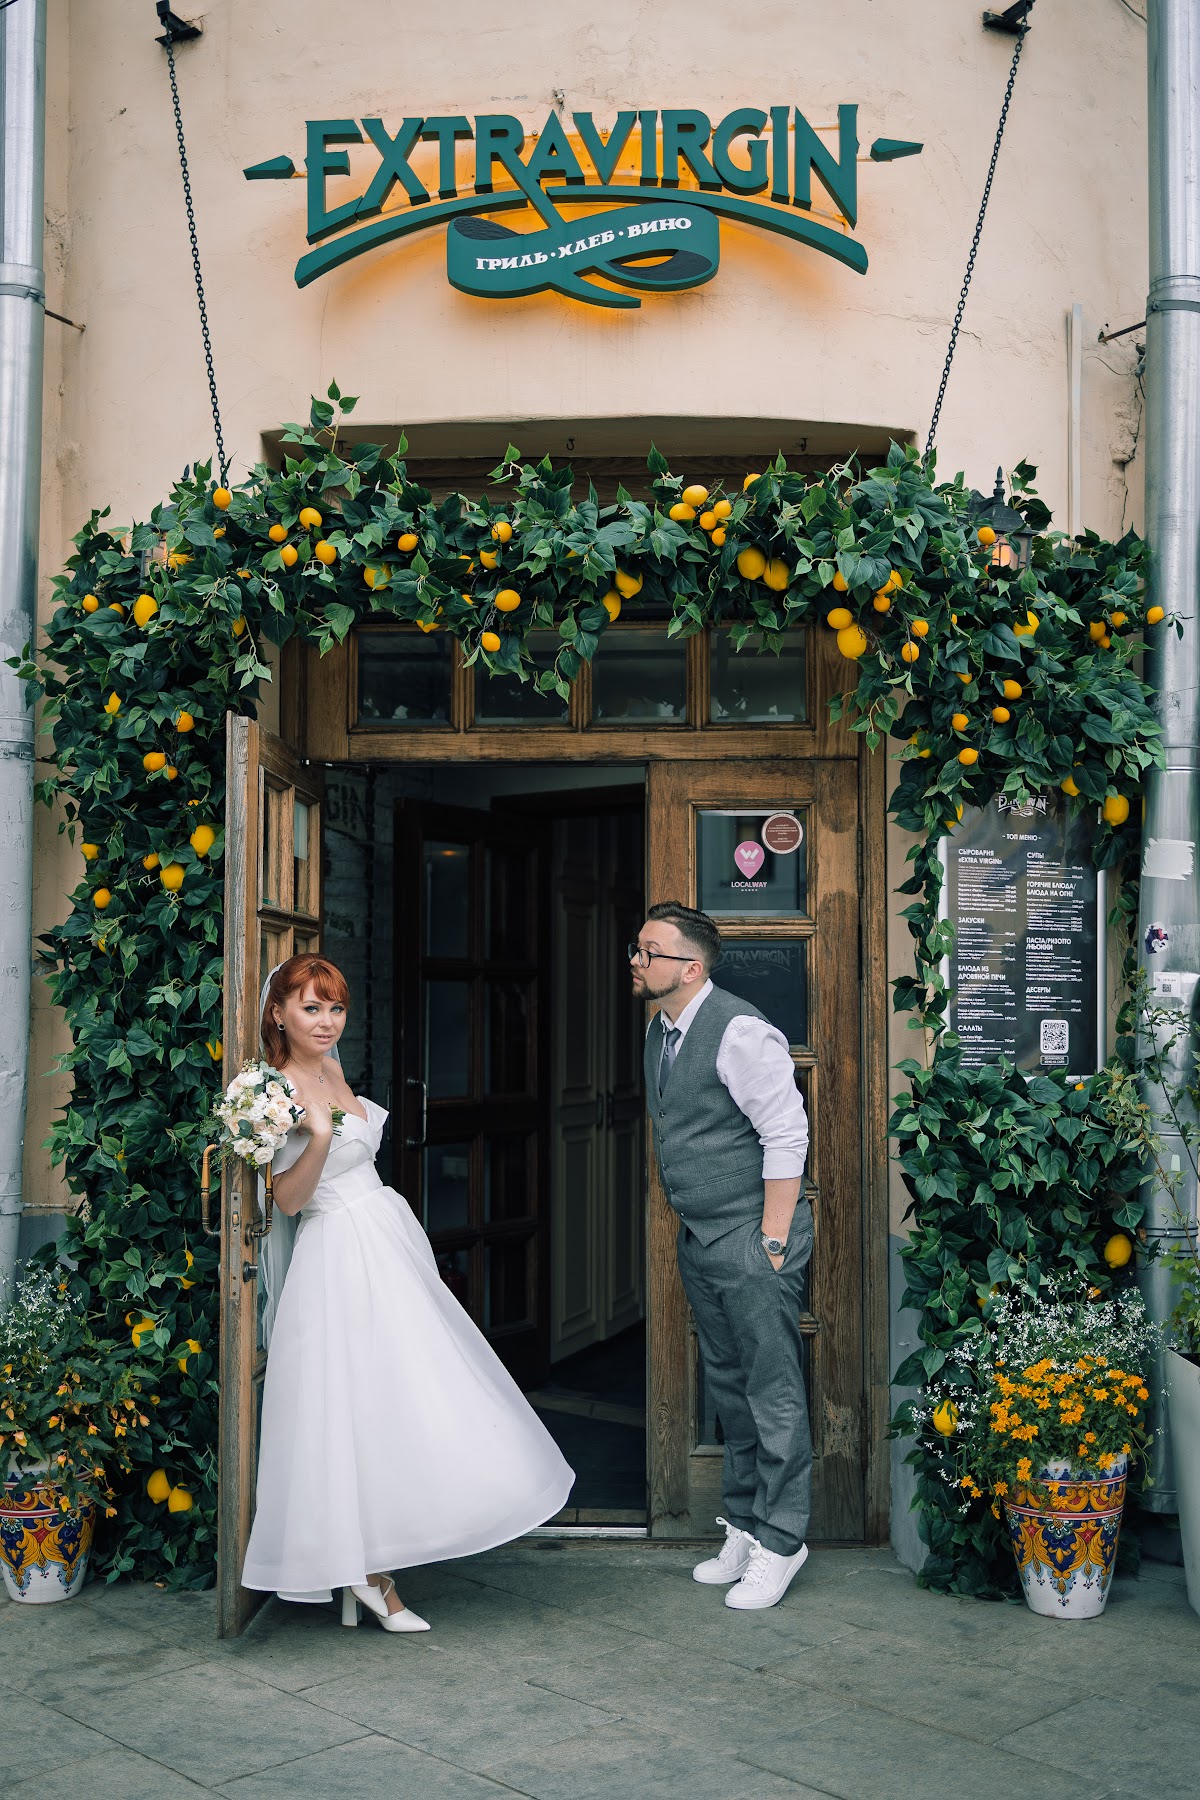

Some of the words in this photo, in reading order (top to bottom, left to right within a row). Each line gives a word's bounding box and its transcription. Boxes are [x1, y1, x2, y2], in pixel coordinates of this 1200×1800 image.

[306, 104, 859, 245] EXTRAVIRGIN
[476, 251, 548, 270] ГРИЛЬ
[558, 230, 615, 259] ХЛЕБ
[627, 217, 692, 239] ВИНО
[958, 916, 985, 924] ЗАКУСКИ
[957, 1024, 983, 1032] САЛАТЫ
